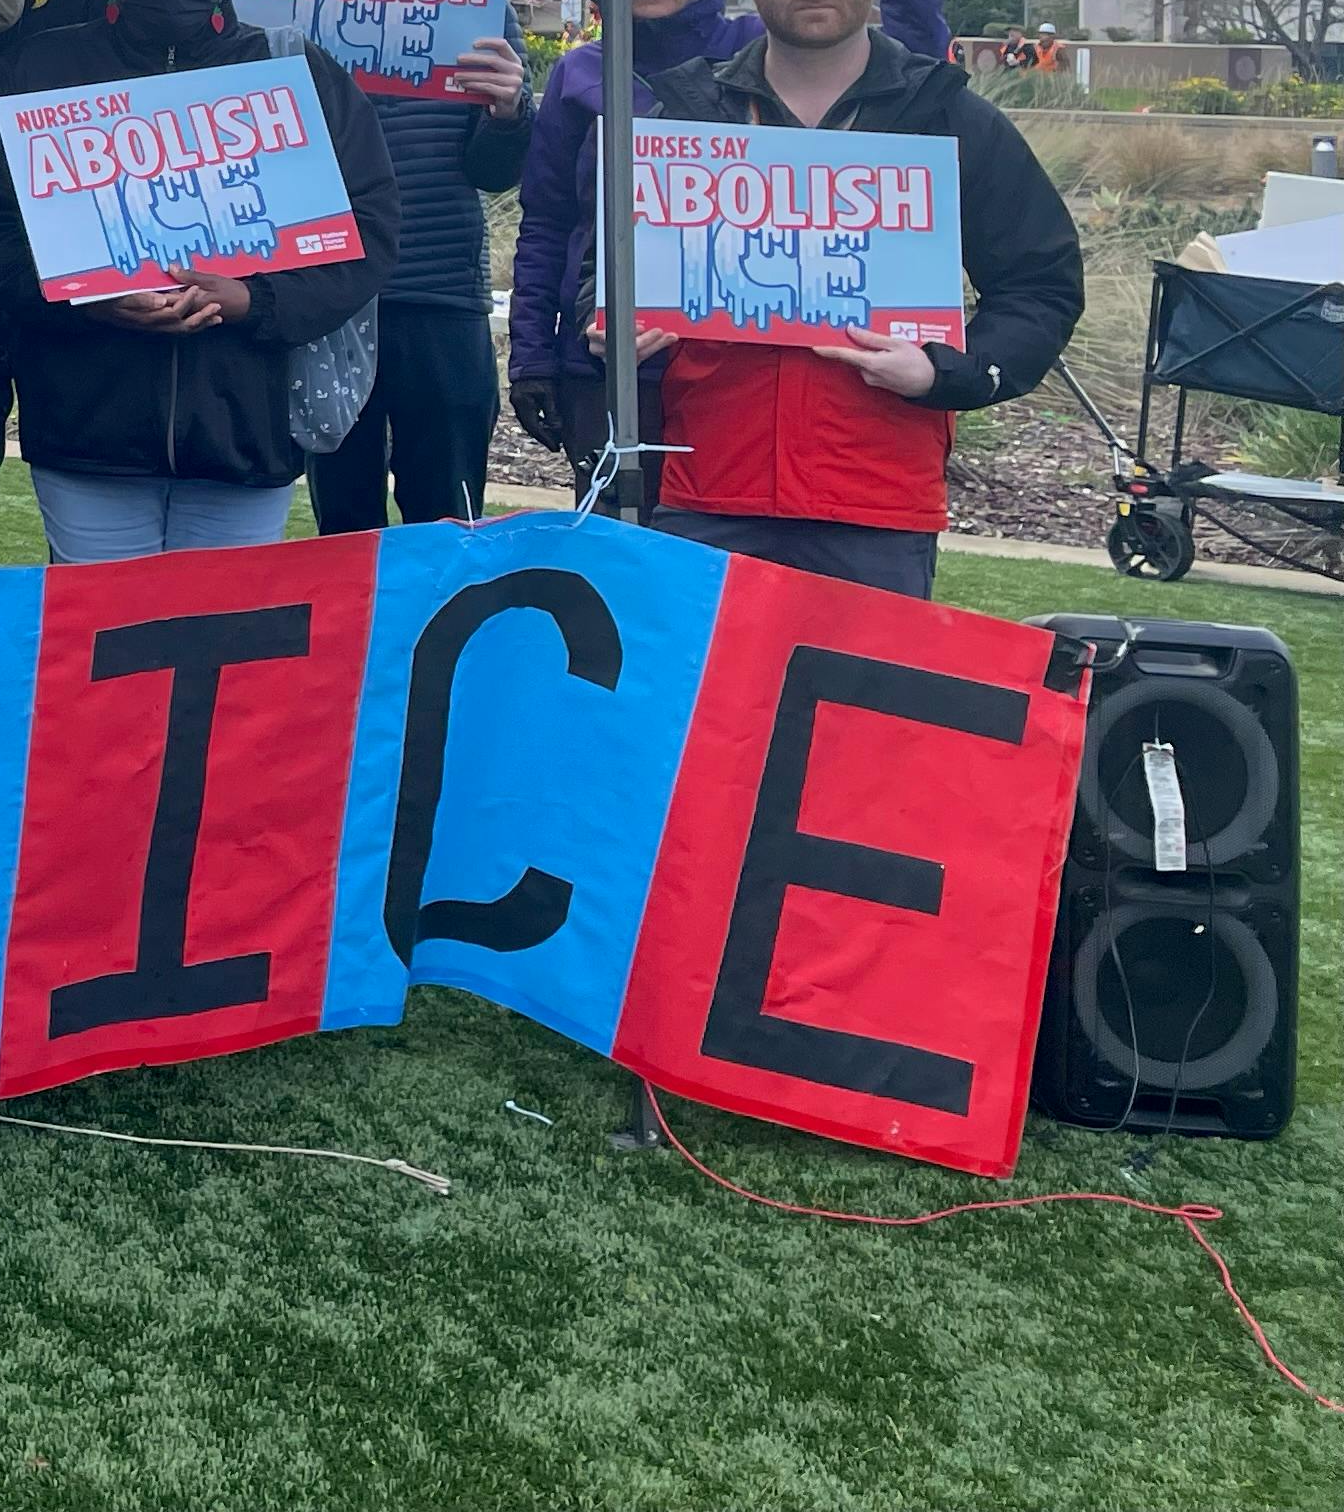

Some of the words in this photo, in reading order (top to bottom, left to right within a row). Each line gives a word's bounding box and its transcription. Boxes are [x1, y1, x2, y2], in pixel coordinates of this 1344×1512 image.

[15, 99, 92, 134] NURSES
[95, 91, 131, 118] SAY
[30, 87, 309, 199] ABOLISH
[635, 135, 703, 159] URSES
[710, 136, 752, 159] SAY
[92, 156, 278, 278] ICE
[632, 162, 934, 232] ABOLISH
[680, 218, 872, 332] ICE
[48, 567, 1030, 1116] ICE
